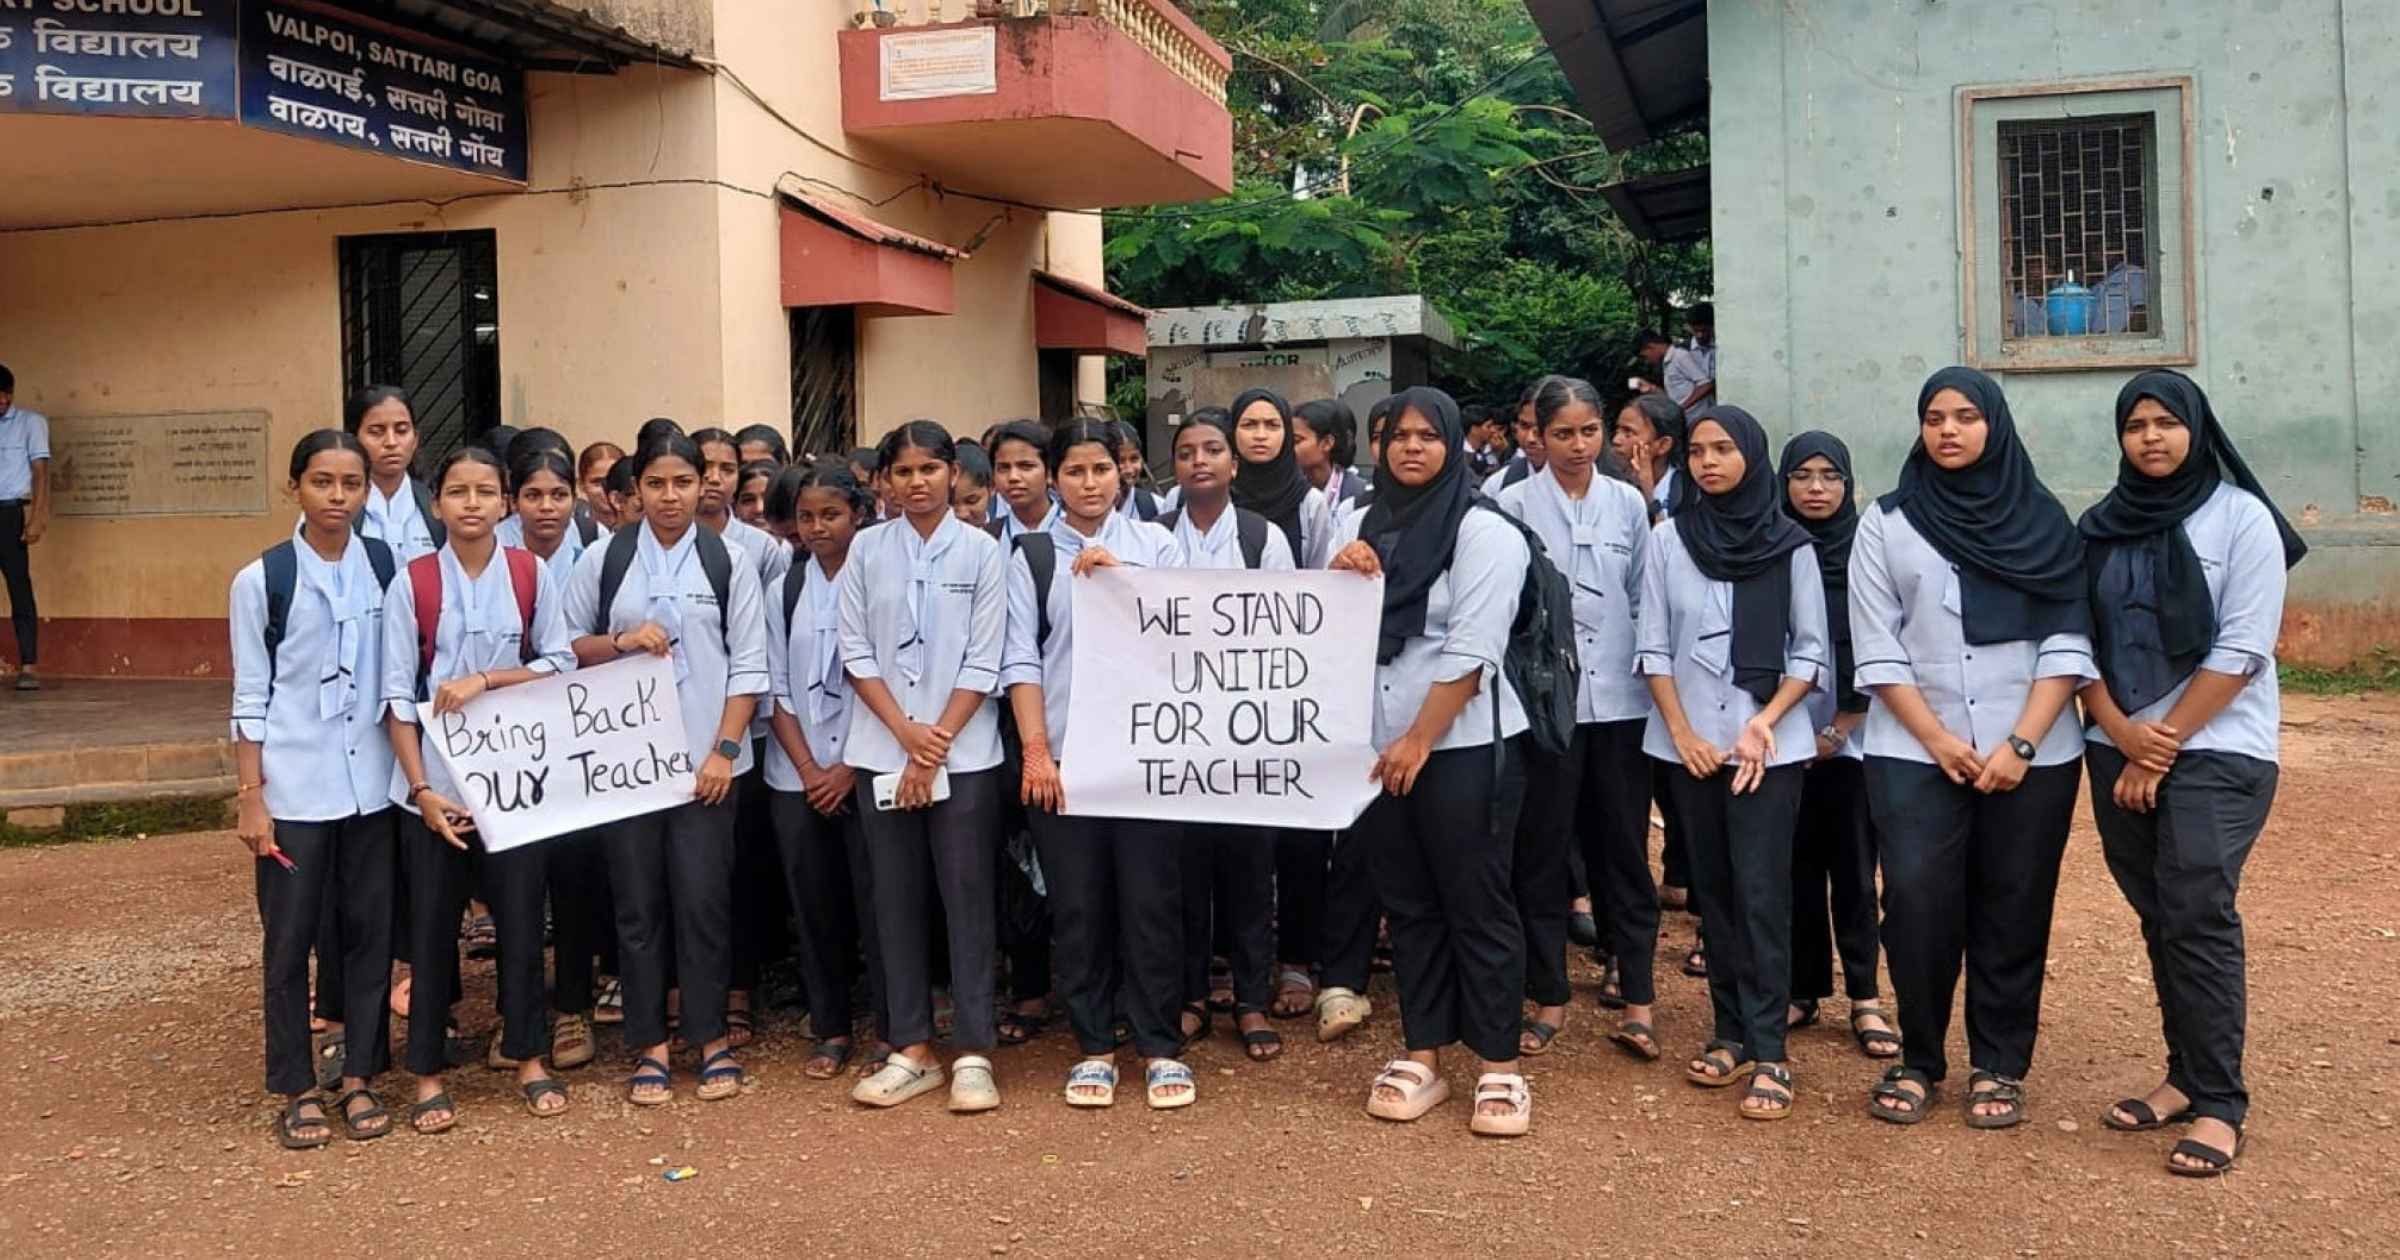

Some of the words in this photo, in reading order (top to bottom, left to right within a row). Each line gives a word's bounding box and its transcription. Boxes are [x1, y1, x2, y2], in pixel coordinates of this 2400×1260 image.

[33, 17, 201, 58] विद्यालय
[266, 11, 363, 60] VALPOI,
[368, 42, 456, 83] SATTARI
[462, 67, 503, 95] GOA
[34, 65, 203, 105] विद्यालय
[386, 85, 449, 121] सत्तरी
[454, 96, 505, 133] गोवा
[389, 124, 453, 157] सत्तरी
[1137, 596, 1192, 636] WE
[1212, 591, 1323, 637] STAND
[1171, 647, 1308, 694] UNITED
[441, 710, 546, 763] Bring
[1131, 701, 1211, 746] FOR
[1228, 697, 1331, 746] OUR
[567, 742, 693, 798] Teacher
[1137, 758, 1314, 799] TEACHER
